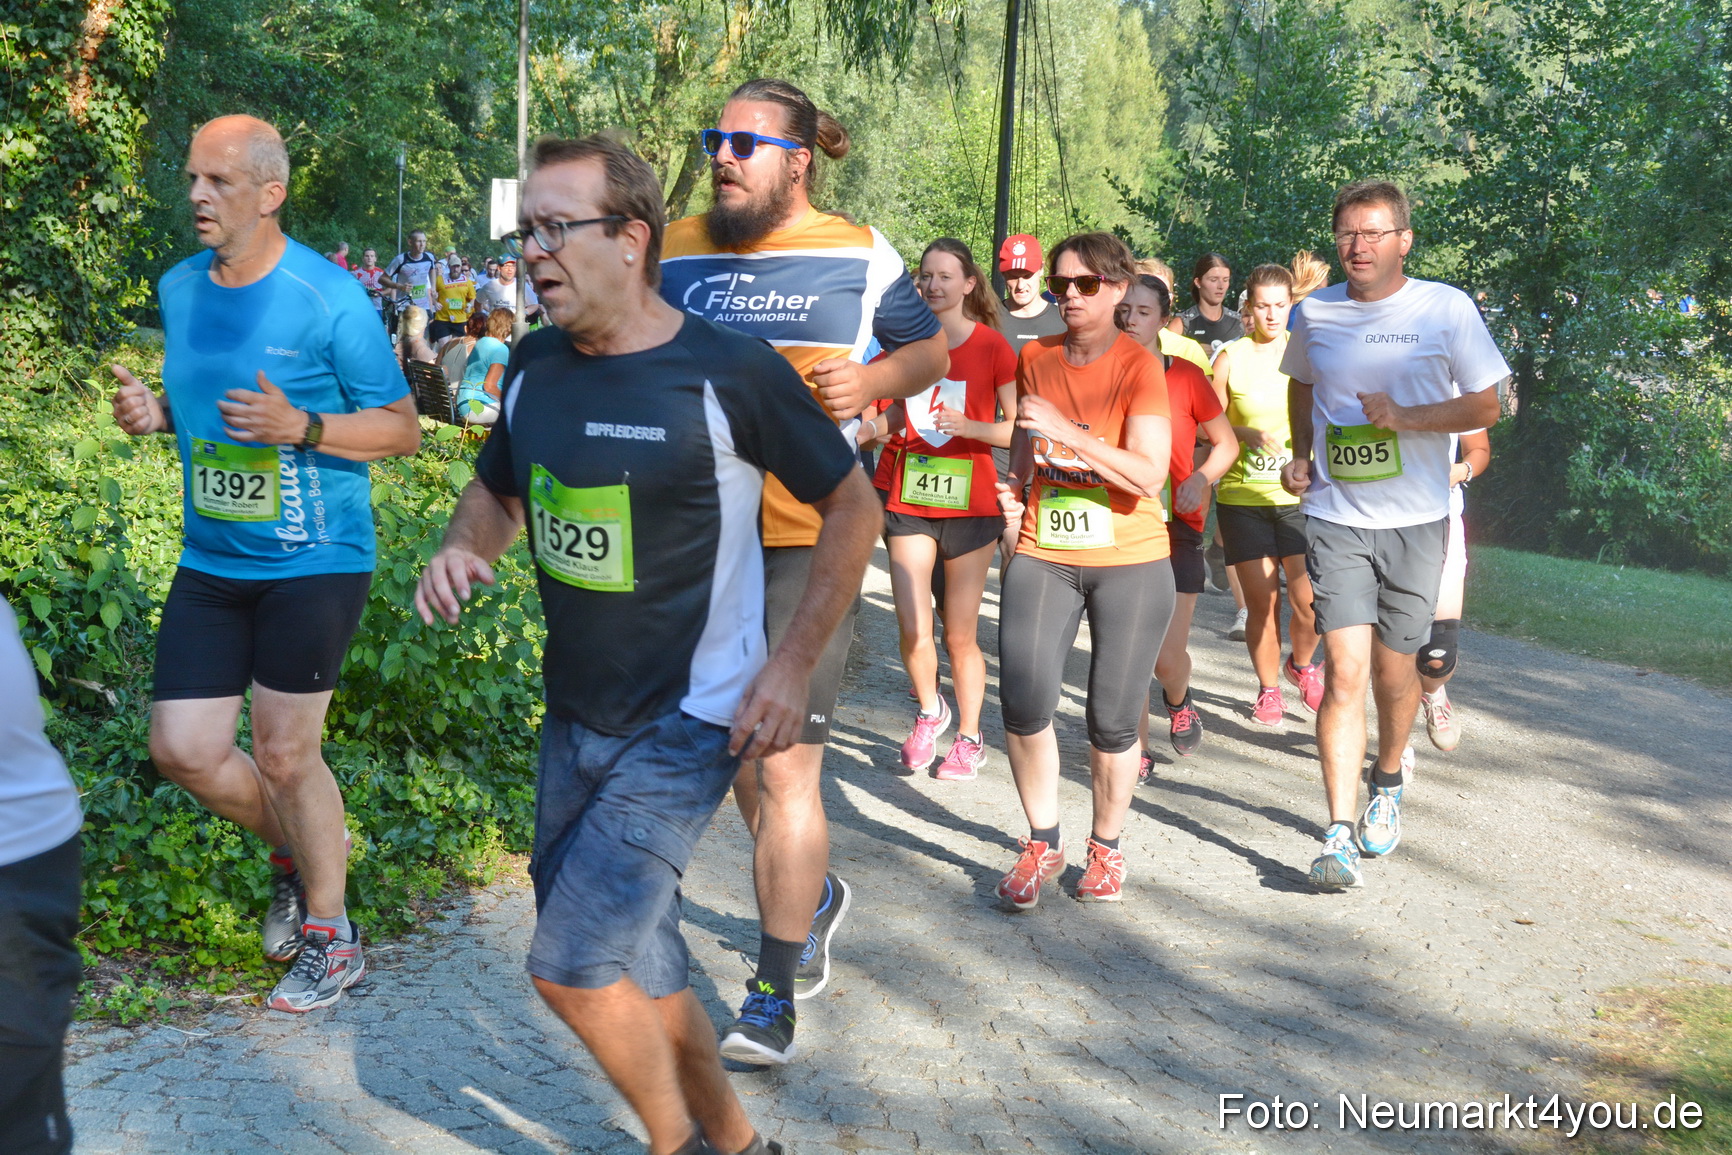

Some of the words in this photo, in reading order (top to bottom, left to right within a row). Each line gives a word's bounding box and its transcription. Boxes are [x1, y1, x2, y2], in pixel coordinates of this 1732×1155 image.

[705, 290, 819, 310] Fischer
[713, 313, 808, 322] AUTOMOBILE
[1365, 334, 1419, 344] GÜNTHER
[597, 423, 666, 441] PFLEIDERER
[1331, 442, 1390, 466] 2095
[1256, 456, 1288, 472] 922
[198, 468, 266, 500] 1392
[916, 473, 953, 494] 411
[232, 501, 259, 509] Robert
[1050, 510, 1090, 532] 901
[537, 508, 610, 561] 1529
[572, 561, 600, 573] Klaus
[810, 713, 826, 723] FILA
